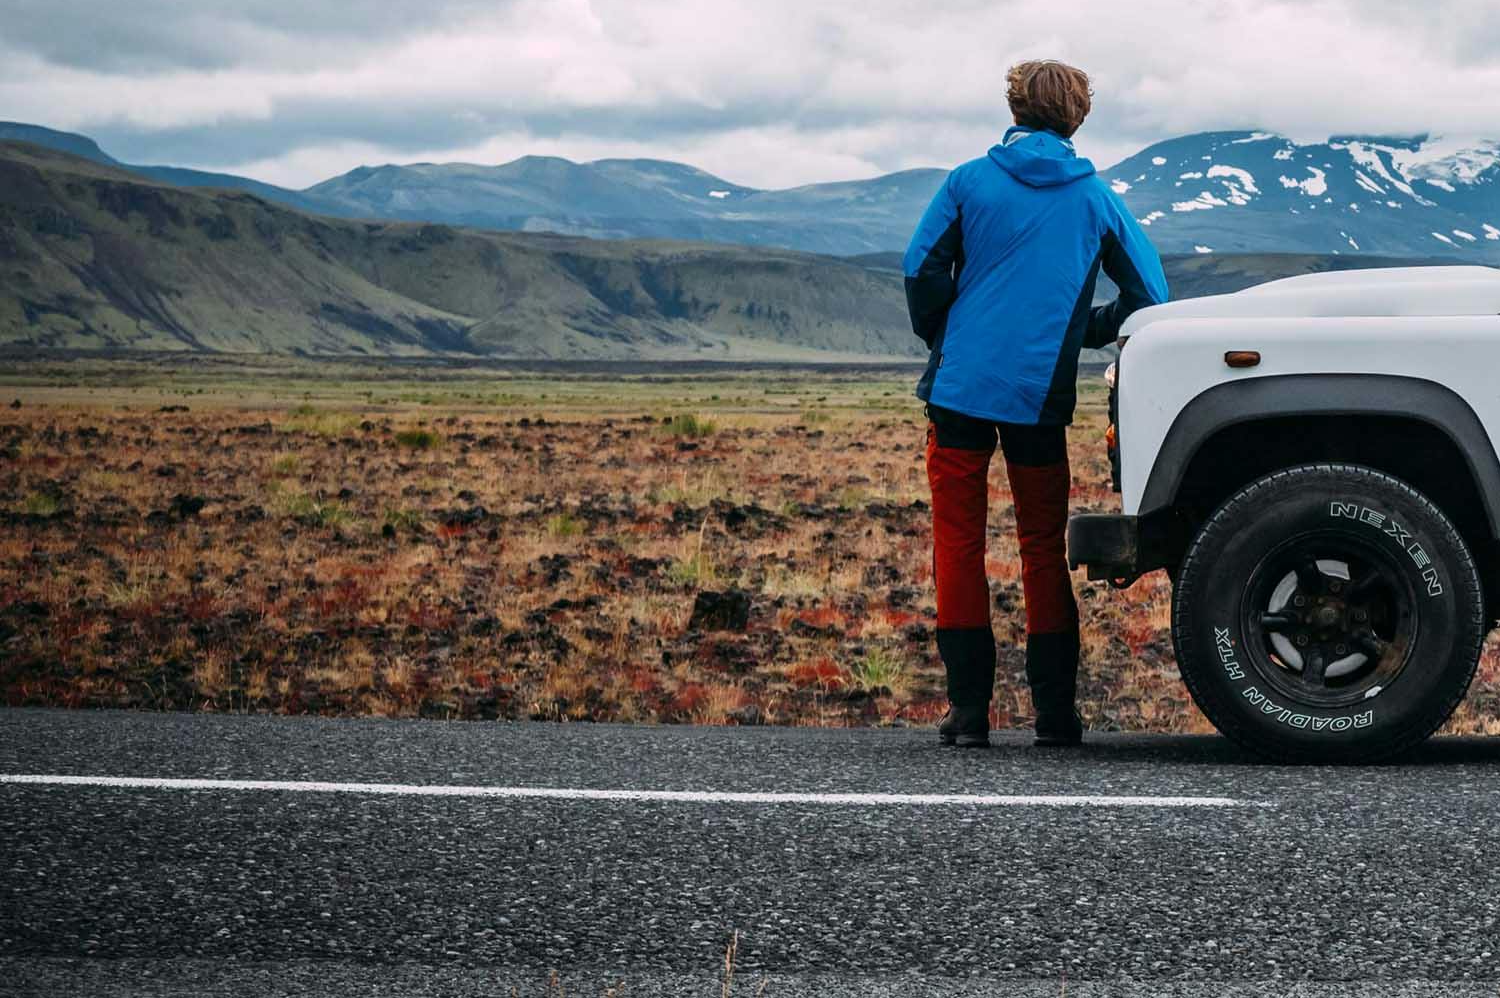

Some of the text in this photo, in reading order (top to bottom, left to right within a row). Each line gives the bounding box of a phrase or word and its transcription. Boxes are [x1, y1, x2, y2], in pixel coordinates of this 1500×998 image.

[1331, 503, 1442, 597] NEXEN
[1214, 627, 1374, 731] ROADIAN HTX
